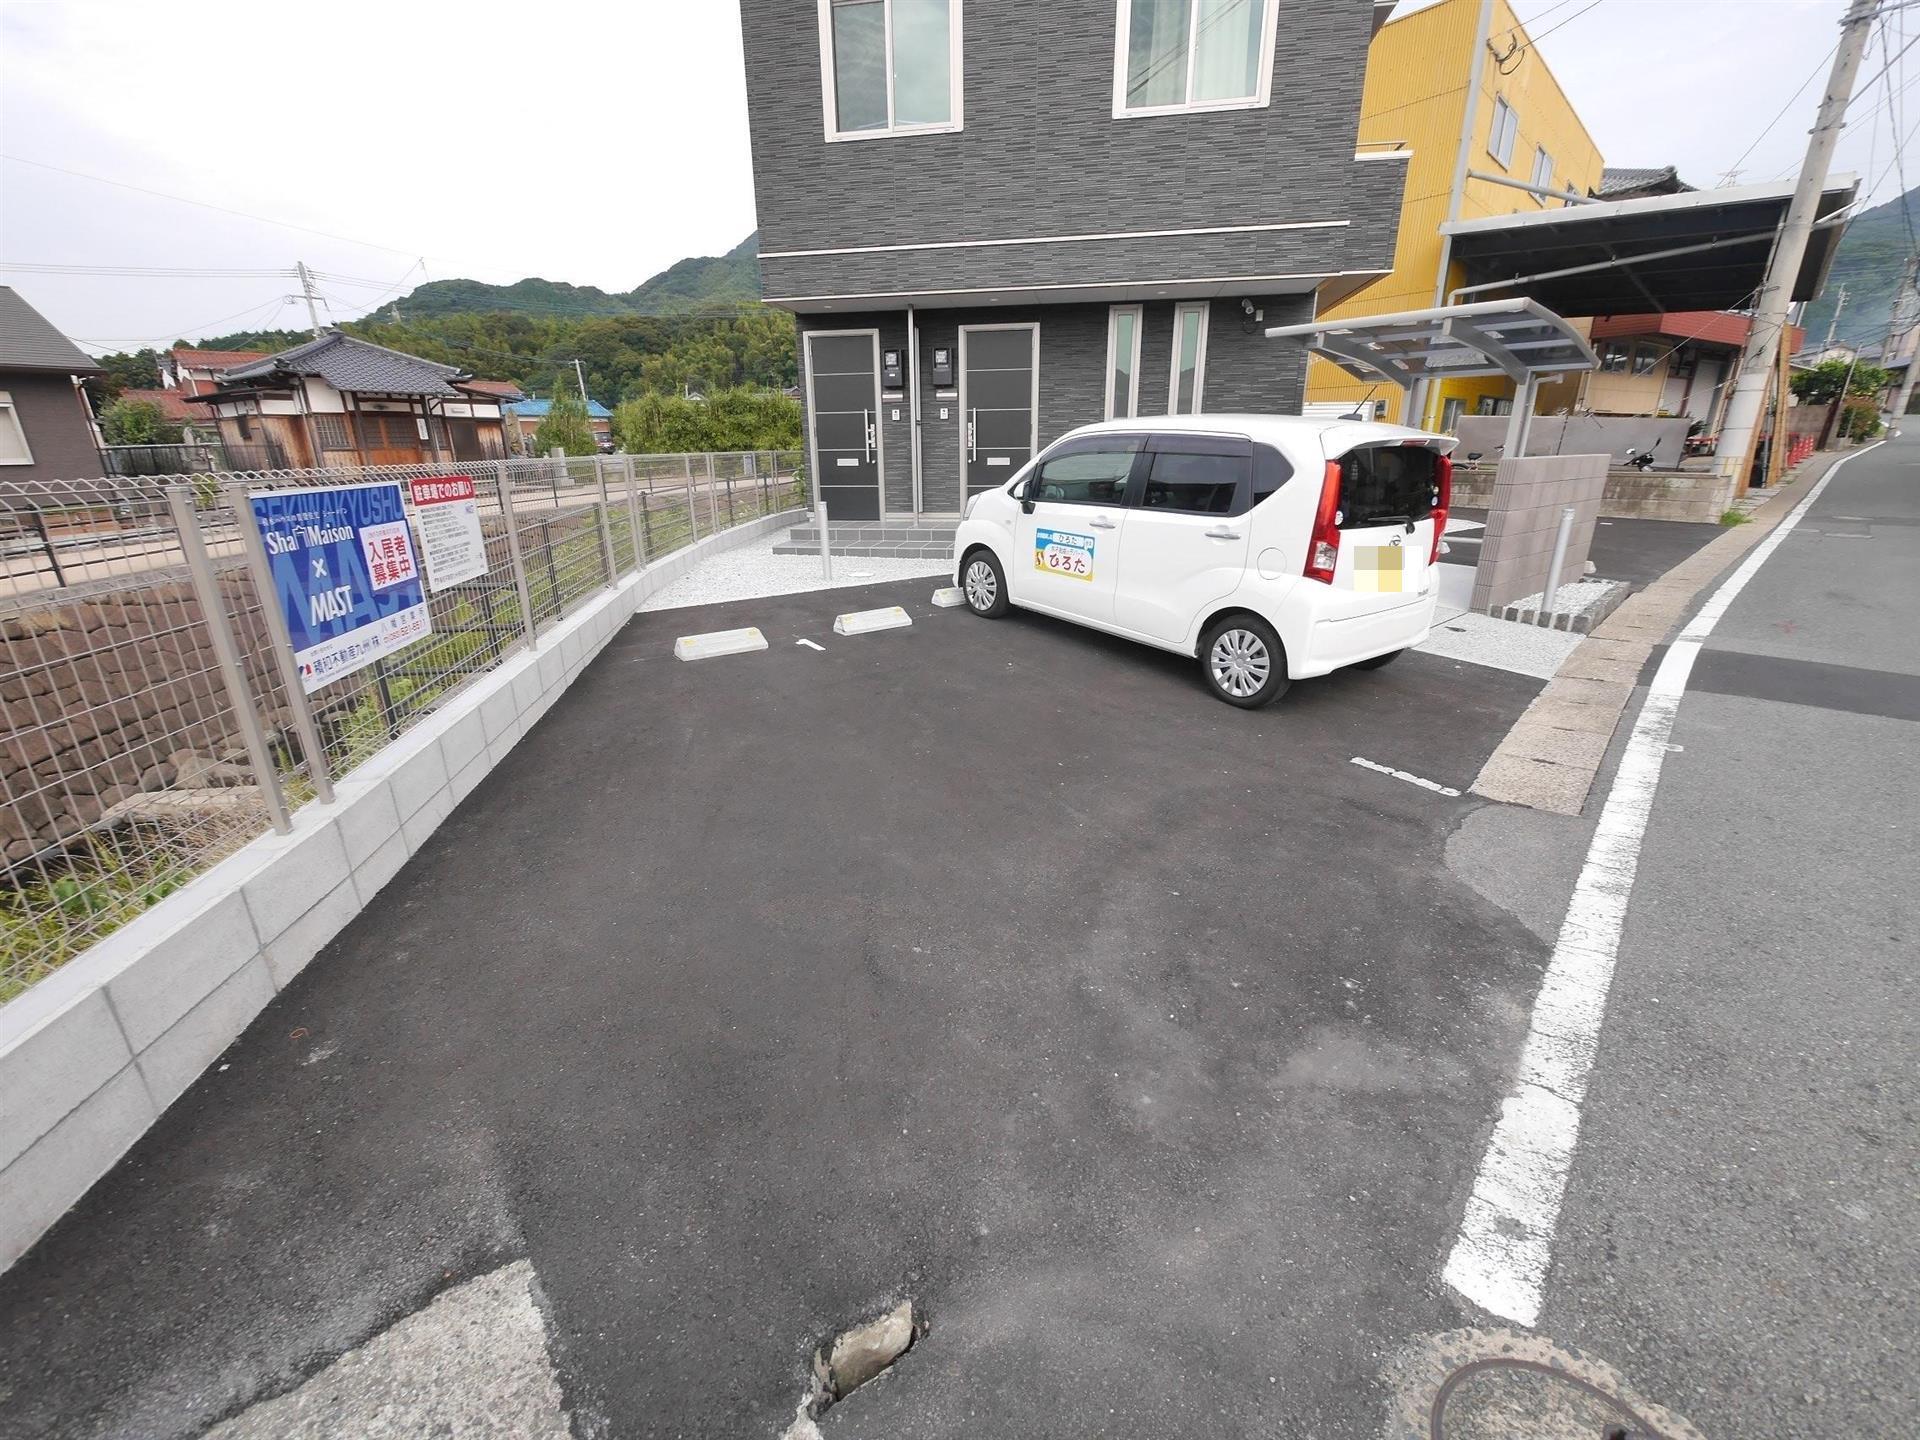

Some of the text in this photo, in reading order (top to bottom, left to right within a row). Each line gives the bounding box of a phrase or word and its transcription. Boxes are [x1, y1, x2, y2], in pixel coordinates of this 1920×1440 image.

[412, 481, 473, 502] 駐車場でのお願い
[368, 535, 407, 563] 入居者
[1058, 534, 1078, 545] ひろた
[371, 557, 412, 586] 募集中
[1049, 553, 1086, 574] ひろた
[311, 585, 354, 627] MAST
